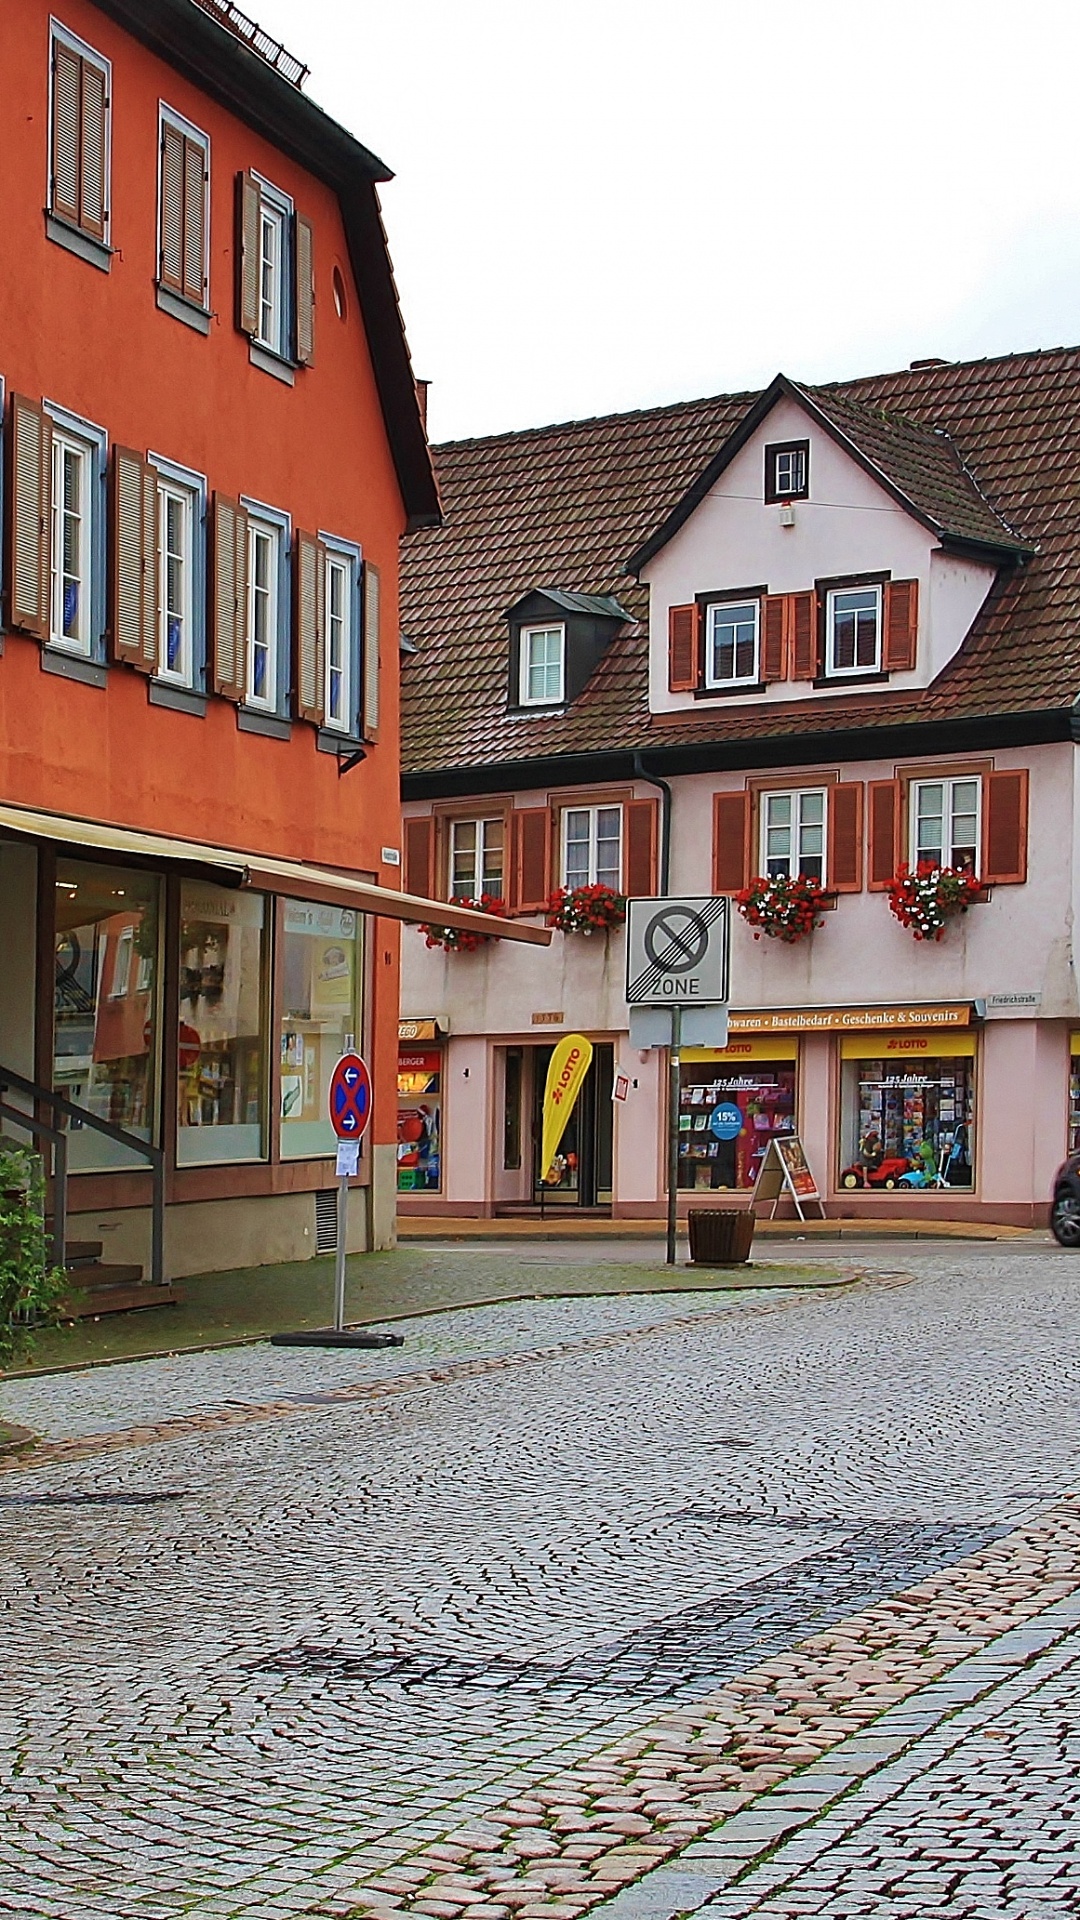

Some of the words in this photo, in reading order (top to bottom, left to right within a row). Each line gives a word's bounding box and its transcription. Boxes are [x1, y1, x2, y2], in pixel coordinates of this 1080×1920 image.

[651, 978, 700, 995] ZONE
[992, 994, 1036, 1004] Friedrichstraße
[772, 1013, 833, 1027] Bastelbedarf
[842, 1012, 895, 1025] Geschenke
[897, 1011, 906, 1023] &
[909, 1010, 958, 1023] Souvenirs
[399, 1025, 417, 1038] EGO
[725, 1044, 752, 1053] LOTTO
[899, 1039, 928, 1049] LOTTO
[558, 1048, 580, 1089] LOTTO
[713, 1078, 727, 1088] 125
[728, 1076, 754, 1086] Jahre
[901, 1073, 928, 1083] Jahre
[717, 1111, 737, 1122] 15%
